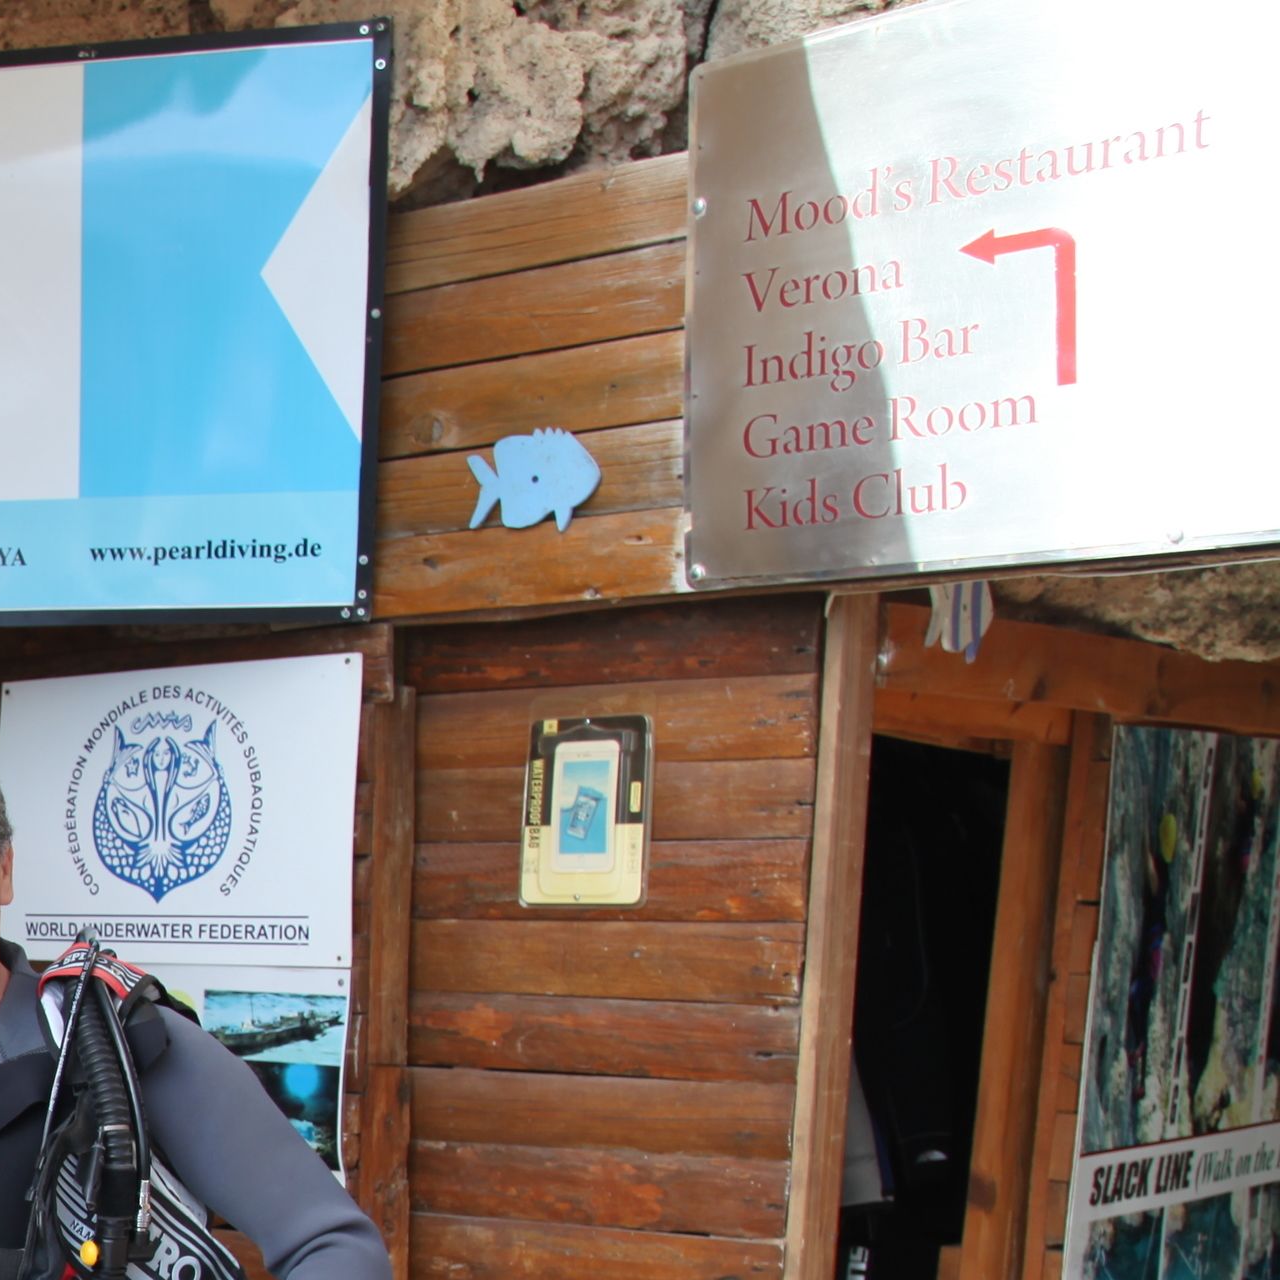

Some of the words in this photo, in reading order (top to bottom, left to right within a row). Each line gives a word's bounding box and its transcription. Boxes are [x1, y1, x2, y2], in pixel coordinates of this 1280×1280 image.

[743, 165, 914, 244] Mood's
[927, 109, 1212, 209] Restaurant
[741, 257, 905, 313] Verona
[742, 330, 884, 393] Indigo
[897, 317, 980, 367] Bar
[743, 411, 876, 460] Game
[888, 392, 1039, 443] Room
[743, 478, 840, 531] Kids
[852, 464, 968, 521] Club
[89, 538, 322, 567] www.pearldiving.de
[64, 755, 100, 896] CONFÉDÉRATION
[83, 689, 148, 755] MONDIALE
[152, 685, 182, 701] DES
[184, 687, 249, 745] ACTIVITÉS
[219, 745, 265, 897] SUBAQUATIQUES
[25, 920, 78, 938] WORLD
[198, 922, 310, 941] FEDERATION
[1090, 1159, 1150, 1207] SLACK
[1155, 1150, 1195, 1194] LINE
